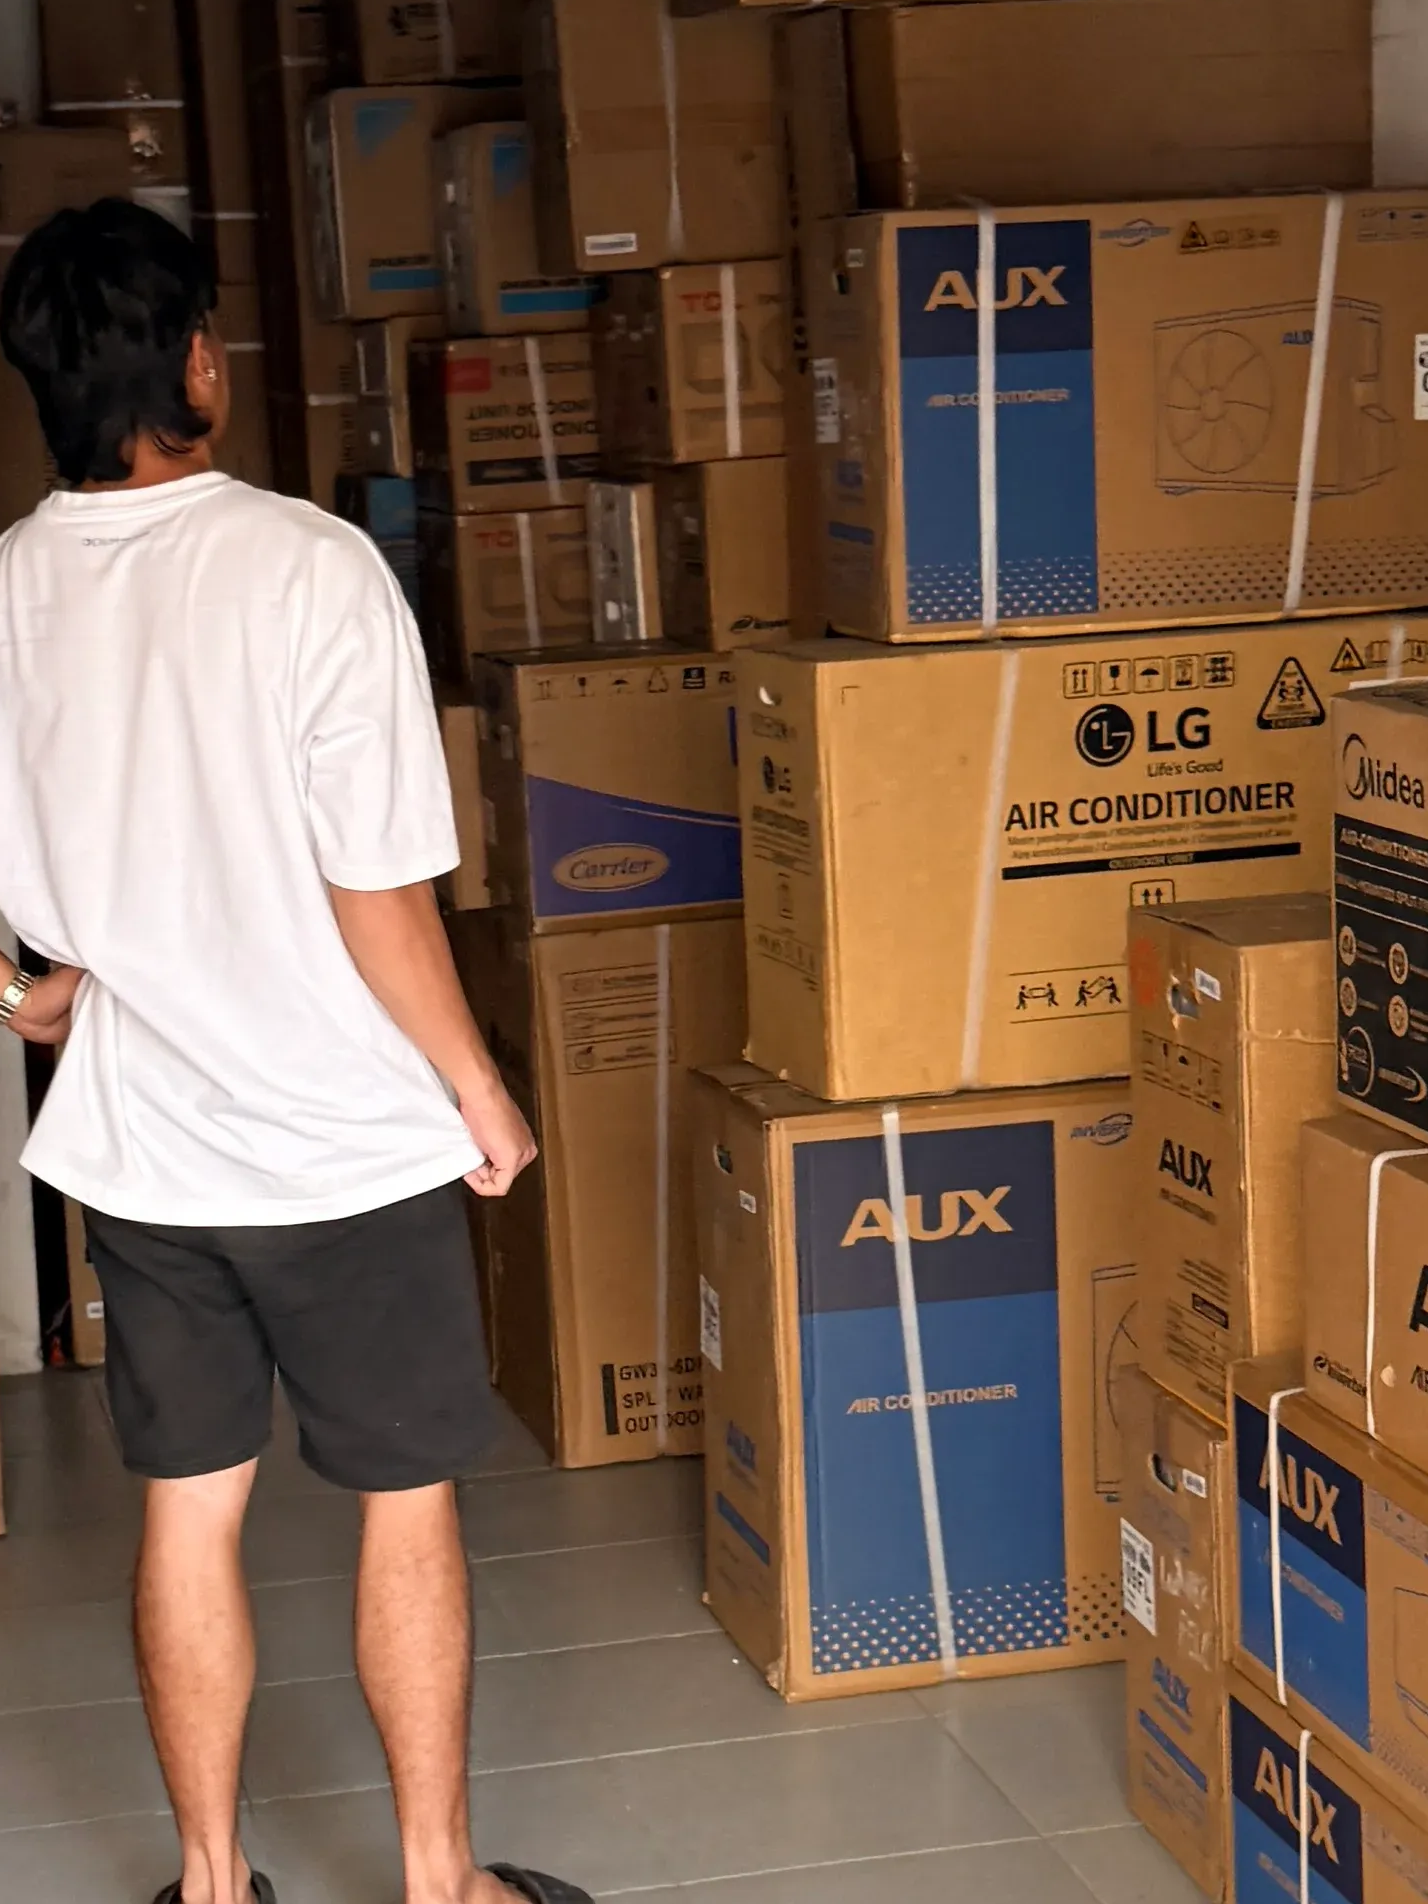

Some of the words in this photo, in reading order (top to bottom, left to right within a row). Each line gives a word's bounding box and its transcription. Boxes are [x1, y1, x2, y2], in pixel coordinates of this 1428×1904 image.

[1146, 707, 1212, 752] LG
[1147, 762, 1183, 778] Life's
[1343, 733, 1425, 809] Midea
[1004, 801, 1060, 832] AIR
[1068, 782, 1296, 826] CONDITIONER
[569, 856, 656, 881] Carrier
[1157, 1137, 1214, 1197] AUX
[840, 1185, 1013, 1248] AUX
[845, 1394, 881, 1415] AIR
[1258, 1451, 1344, 1547] AUX
[1253, 1746, 1340, 1865] AUX
